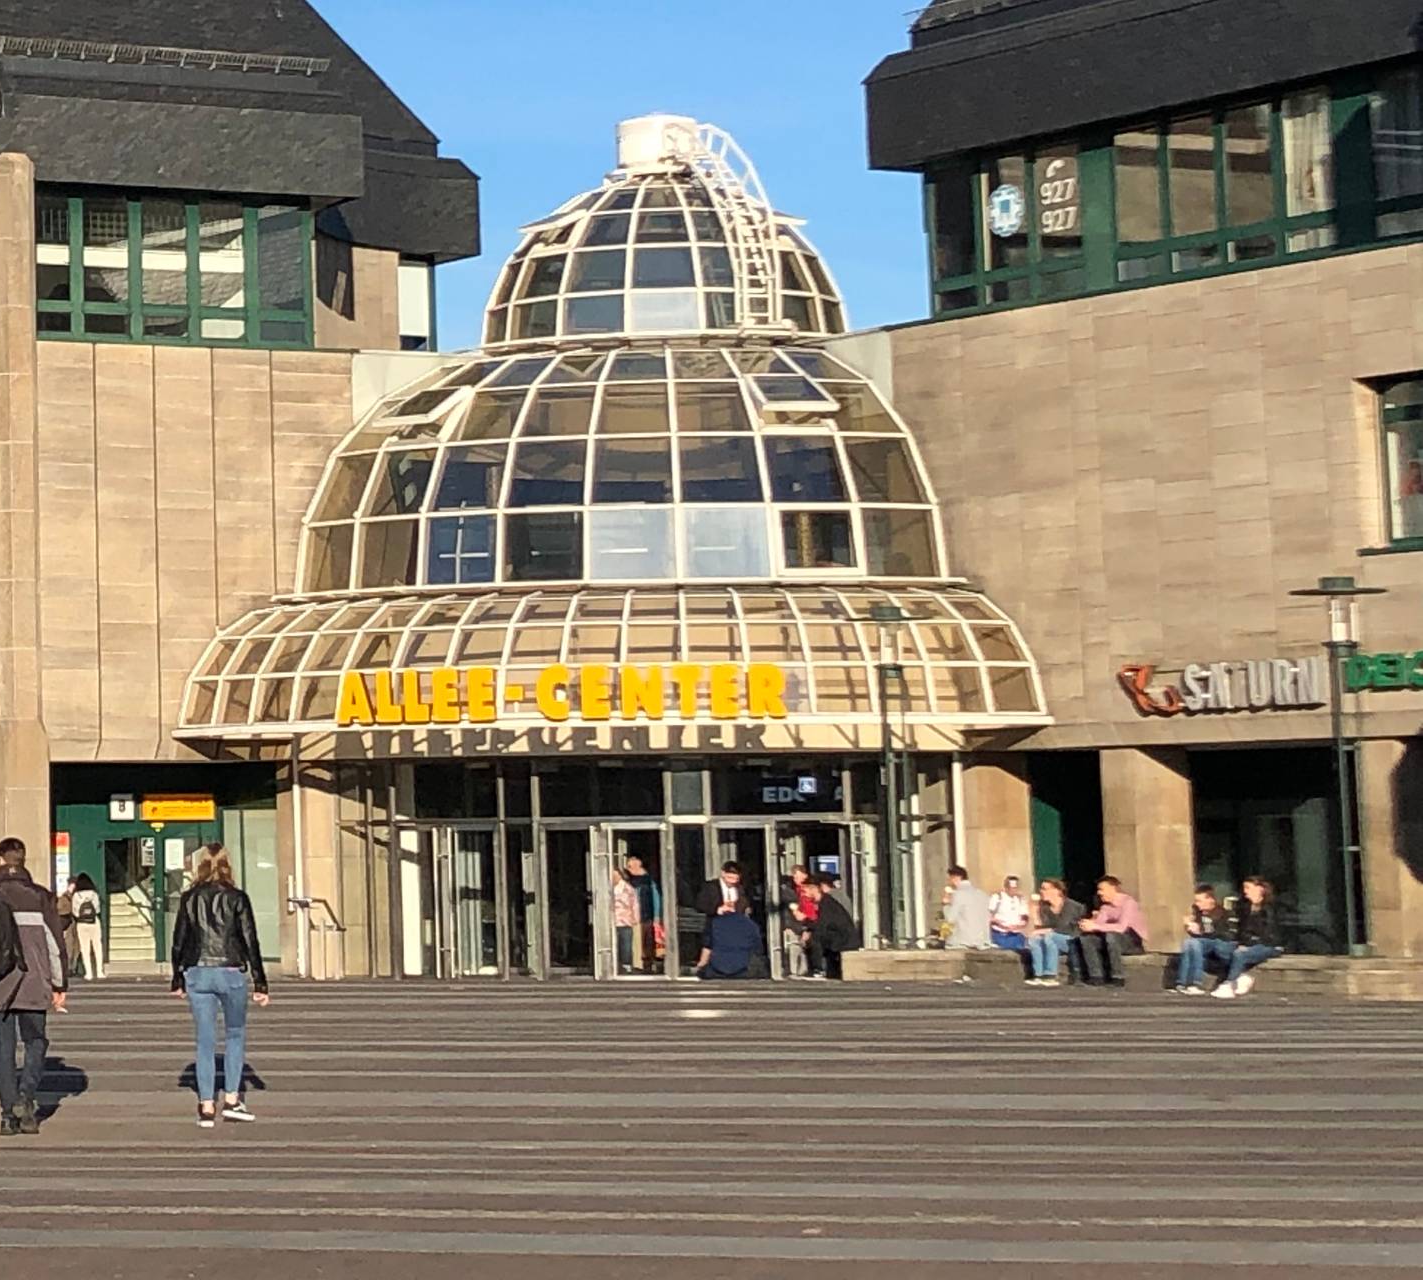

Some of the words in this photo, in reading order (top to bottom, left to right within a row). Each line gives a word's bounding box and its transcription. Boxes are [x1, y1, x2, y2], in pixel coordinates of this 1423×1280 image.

[1040, 178, 1075, 205] 927
[1041, 206, 1077, 233] 927
[337, 663, 789, 726] ALLEE-CENTER
[1183, 655, 1326, 711] SATURN
